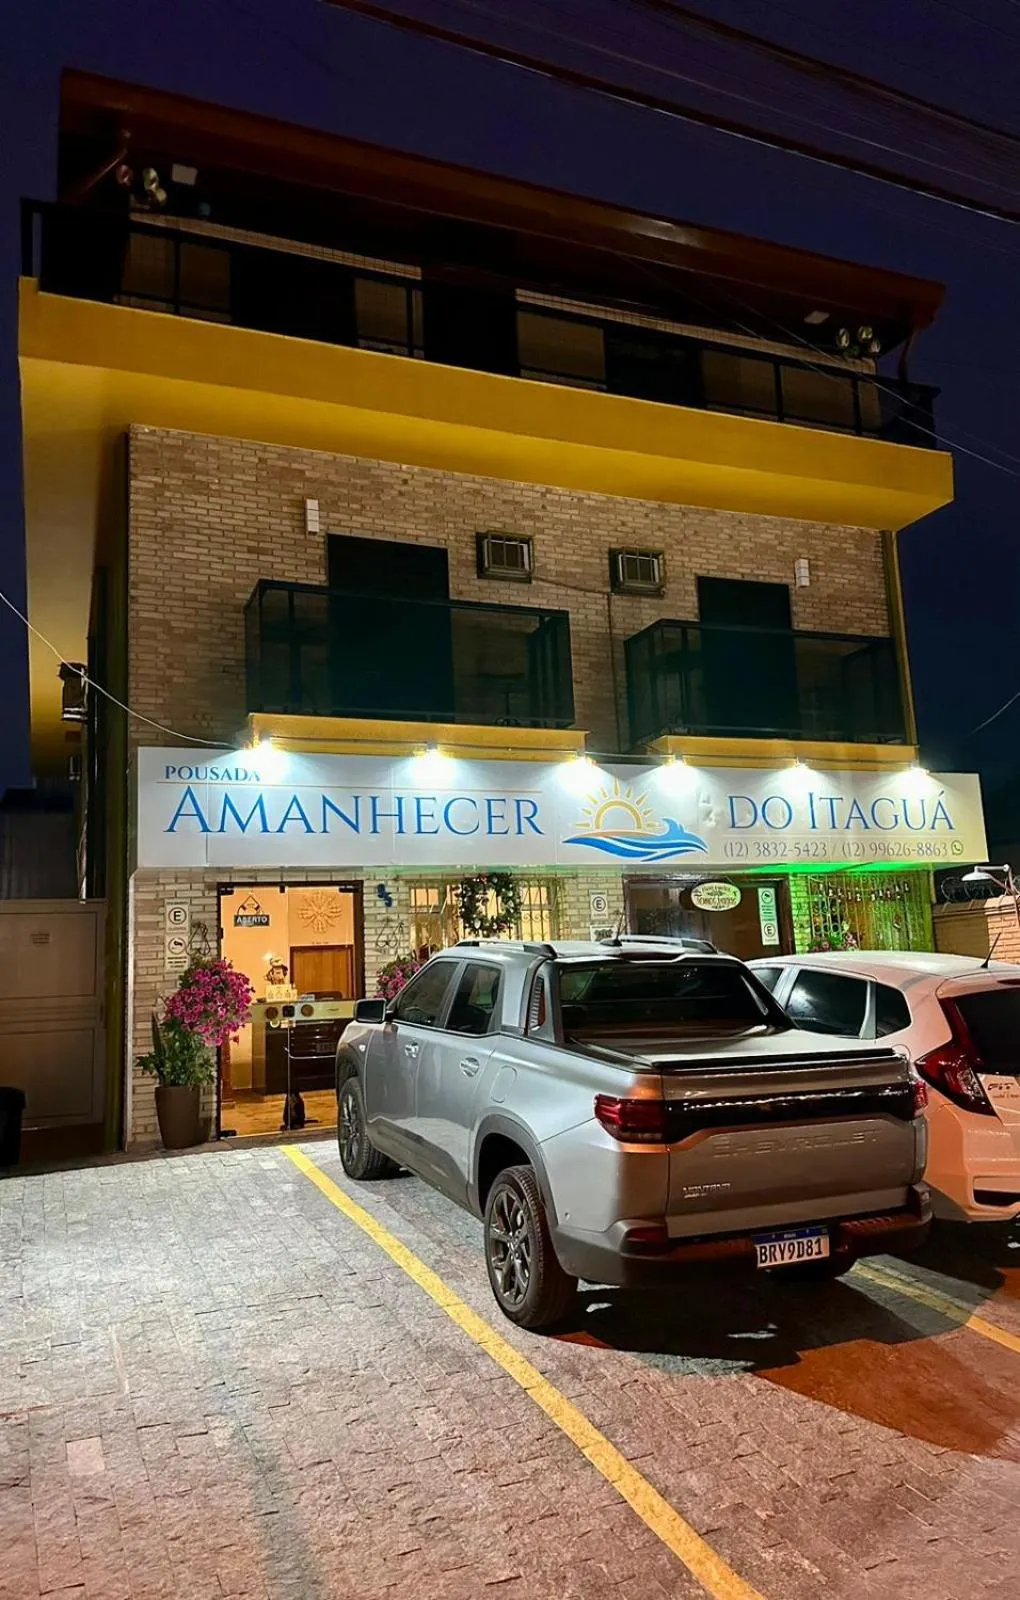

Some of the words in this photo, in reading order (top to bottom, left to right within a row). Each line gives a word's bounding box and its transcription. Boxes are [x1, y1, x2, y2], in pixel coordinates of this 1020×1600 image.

[164, 765, 261, 782] POUSADA
[163, 784, 546, 836] AMANHECER
[728, 795, 793, 830] DO
[808, 790, 956, 831] ITAGUÁ
[723, 841, 749, 859] (12)
[753, 841, 828, 858] 3832-5423
[842, 840, 866, 859] (12)
[868, 839, 949, 858] 99626-8863
[596, 899, 603, 909] E
[173, 910, 182, 922] E
[236, 915, 268, 924] ABERTO
[759, 1237, 823, 1264] BRY9D81
